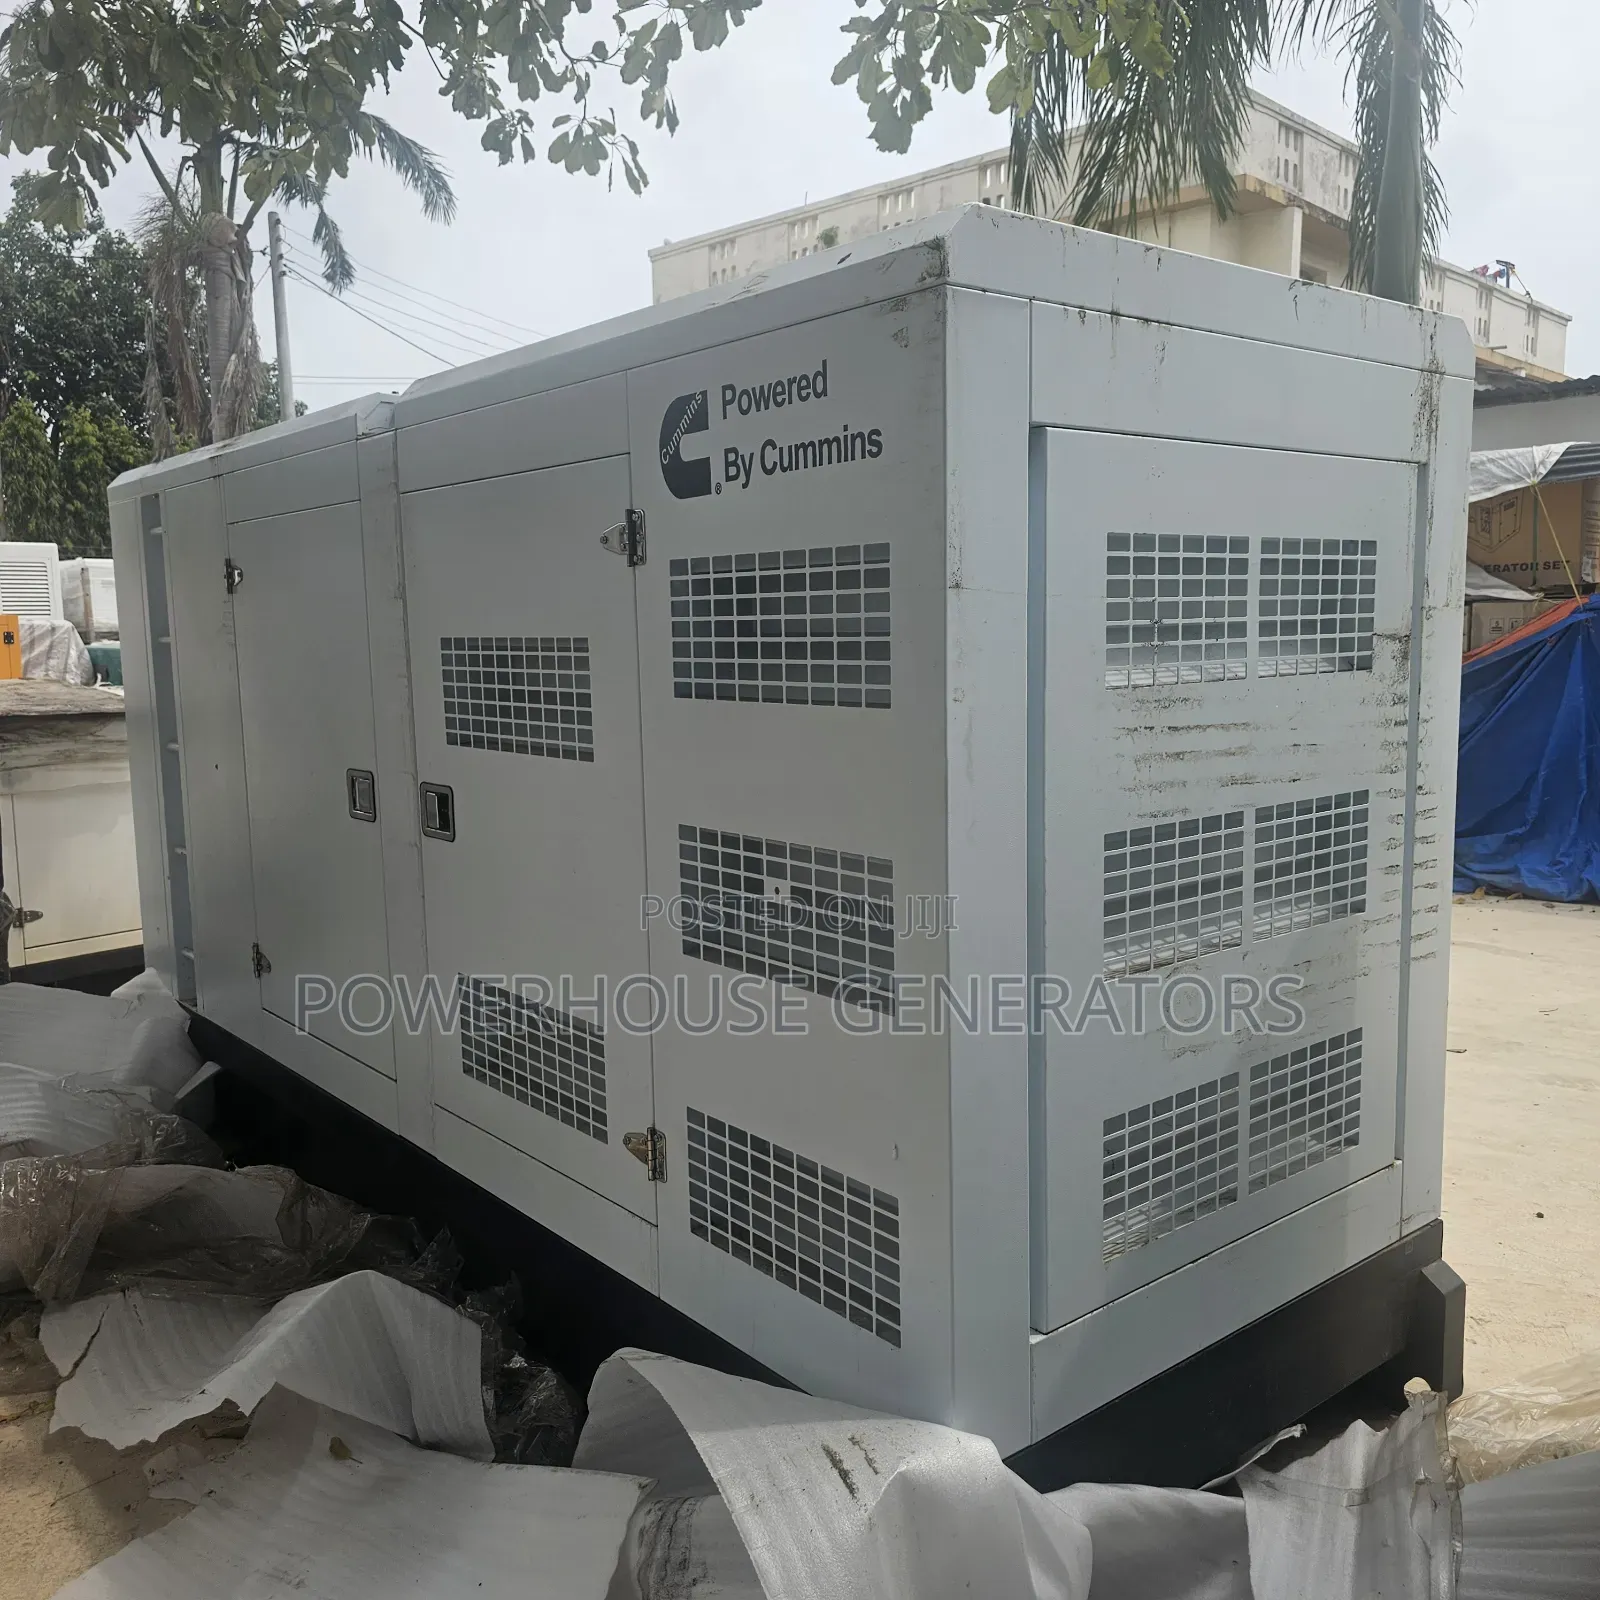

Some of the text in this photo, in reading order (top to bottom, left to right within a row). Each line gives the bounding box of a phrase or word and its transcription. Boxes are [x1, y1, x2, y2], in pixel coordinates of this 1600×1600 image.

[721, 359, 828, 420] Powered
[660, 391, 703, 465] Cummins
[724, 424, 884, 490] By Cummins
[1543, 560, 1570, 571] SET
